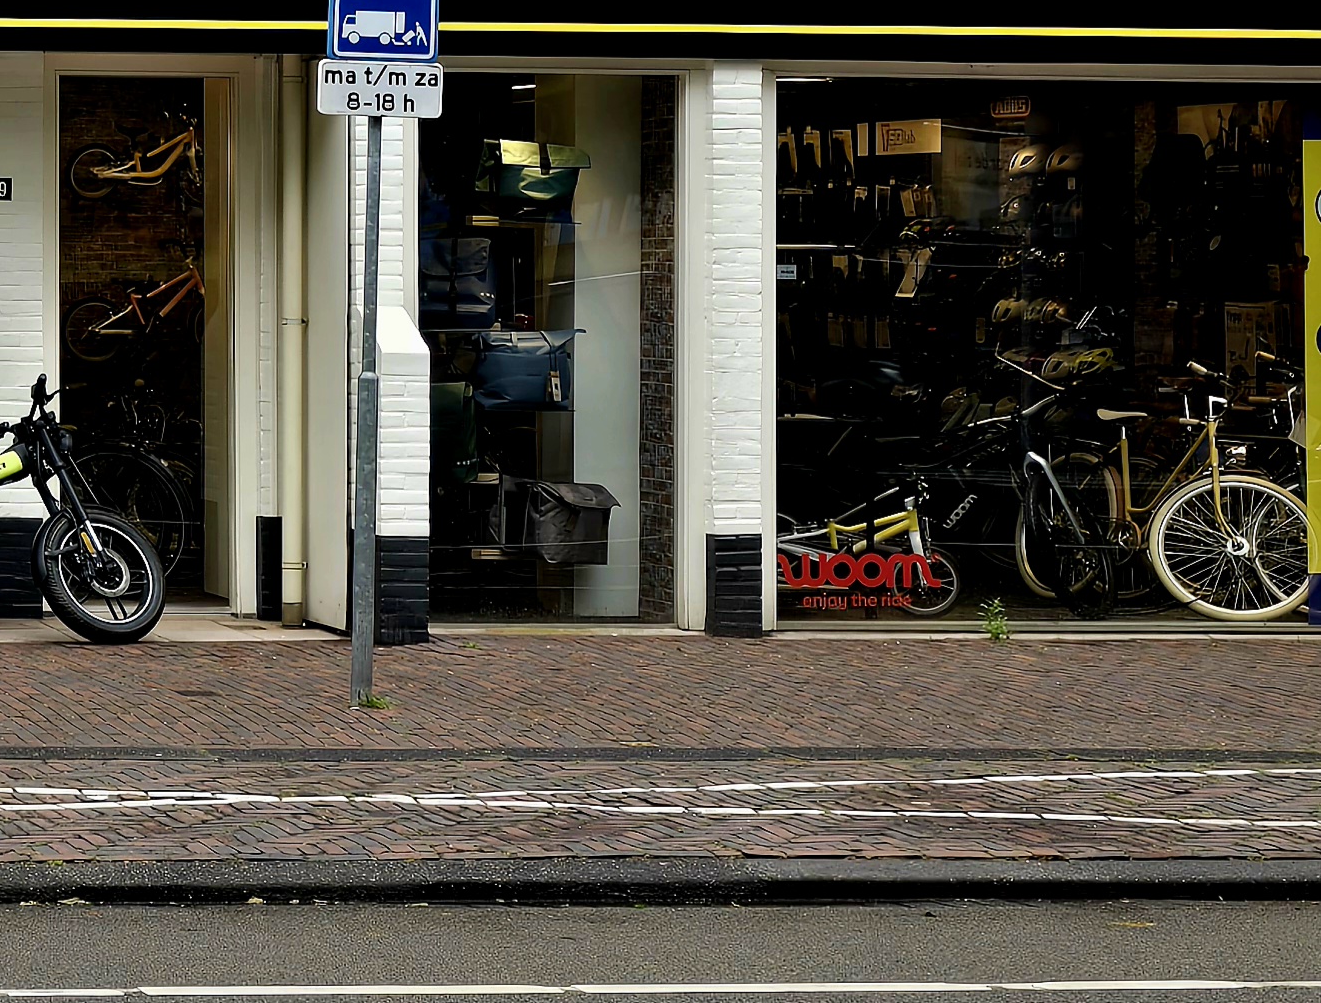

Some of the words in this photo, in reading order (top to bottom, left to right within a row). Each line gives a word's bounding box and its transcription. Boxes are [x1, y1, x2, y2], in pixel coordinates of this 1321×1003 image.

[324, 69, 357, 86] ma
[364, 65, 407, 87] t/m
[414, 71, 439, 87] za
[347, 92, 395, 112] 8-18
[403, 94, 415, 113] h
[942, 494, 978, 529] woom
[778, 553, 942, 588] woom
[803, 593, 847, 610] enjoy
[852, 594, 877, 607] the
[881, 593, 912, 607] ride
